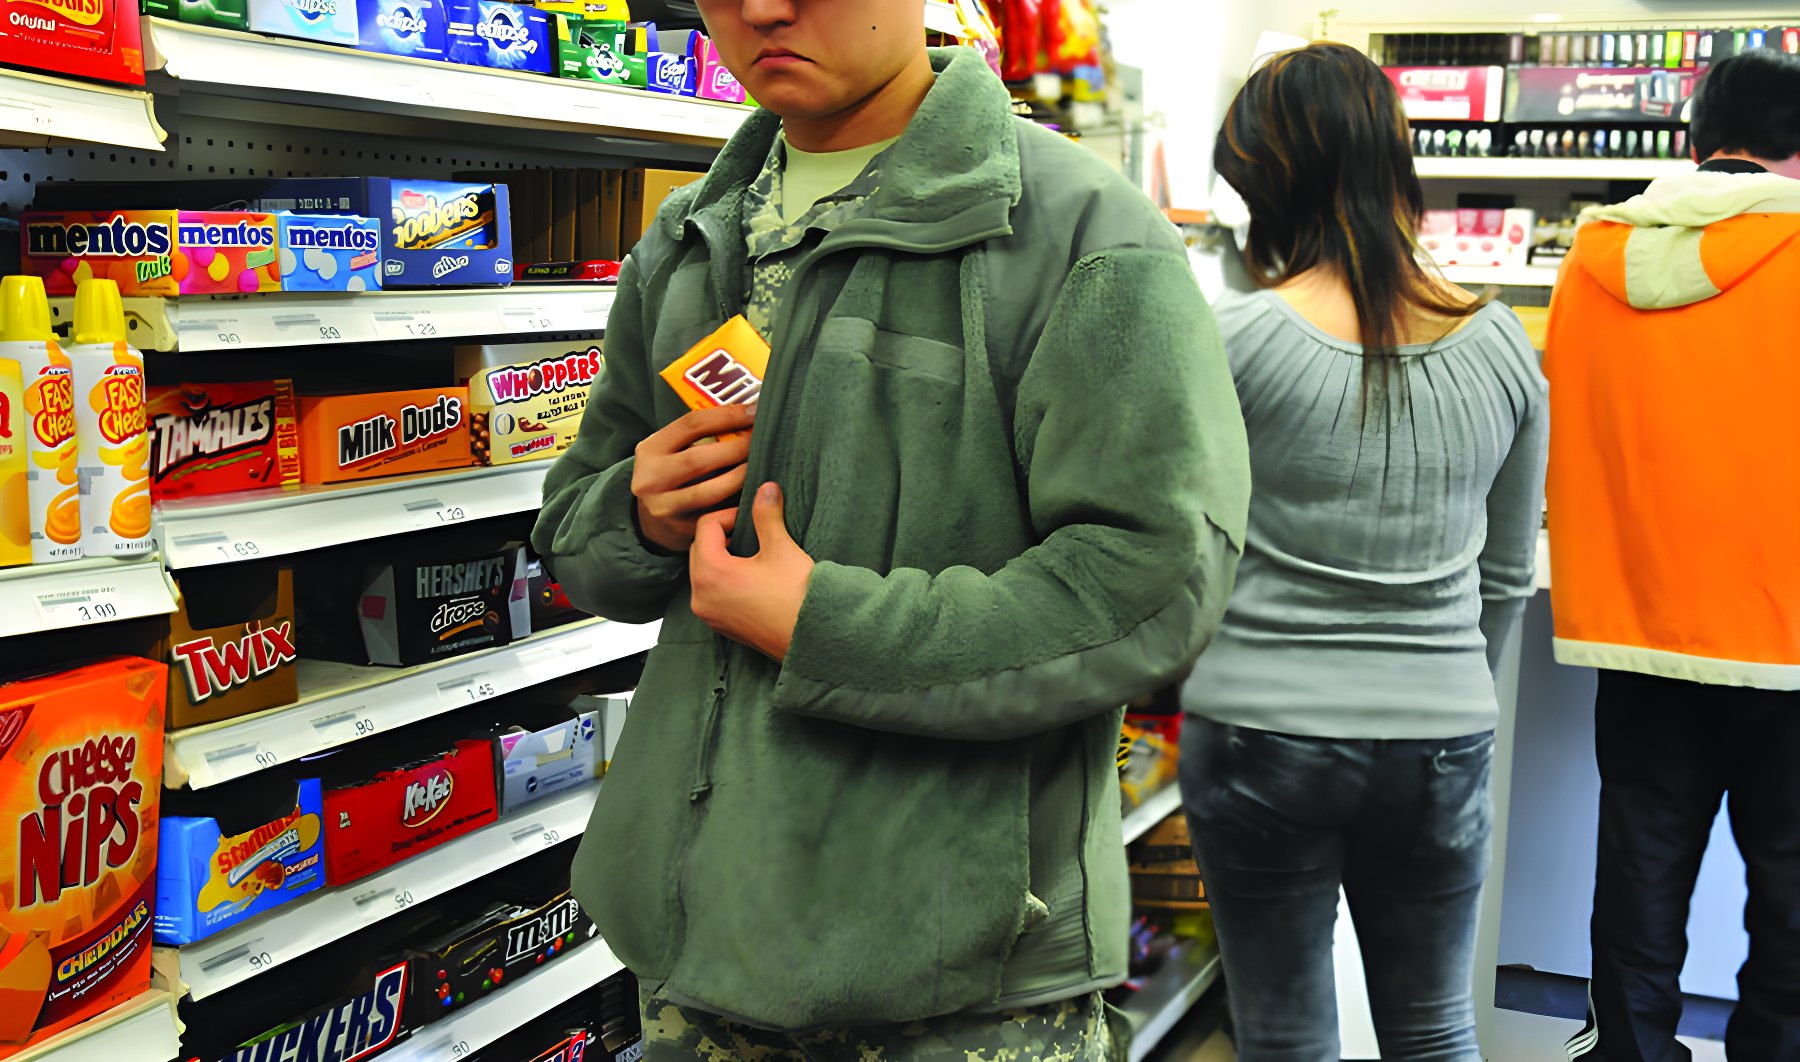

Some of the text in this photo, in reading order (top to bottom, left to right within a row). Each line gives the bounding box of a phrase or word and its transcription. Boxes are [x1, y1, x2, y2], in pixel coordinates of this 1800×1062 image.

[27, 215, 172, 257] mentos
[178, 221, 274, 247] mentos
[288, 226, 378, 250] mentos
[41, 378, 72, 413] EAS
[488, 346, 603, 404] WHOPPERS
[155, 400, 272, 474] TAMALES
[338, 413, 397, 467] Milk
[400, 394, 462, 446] Duds
[416, 556, 505, 599] HERSHEY'S
[430, 601, 486, 633] drops
